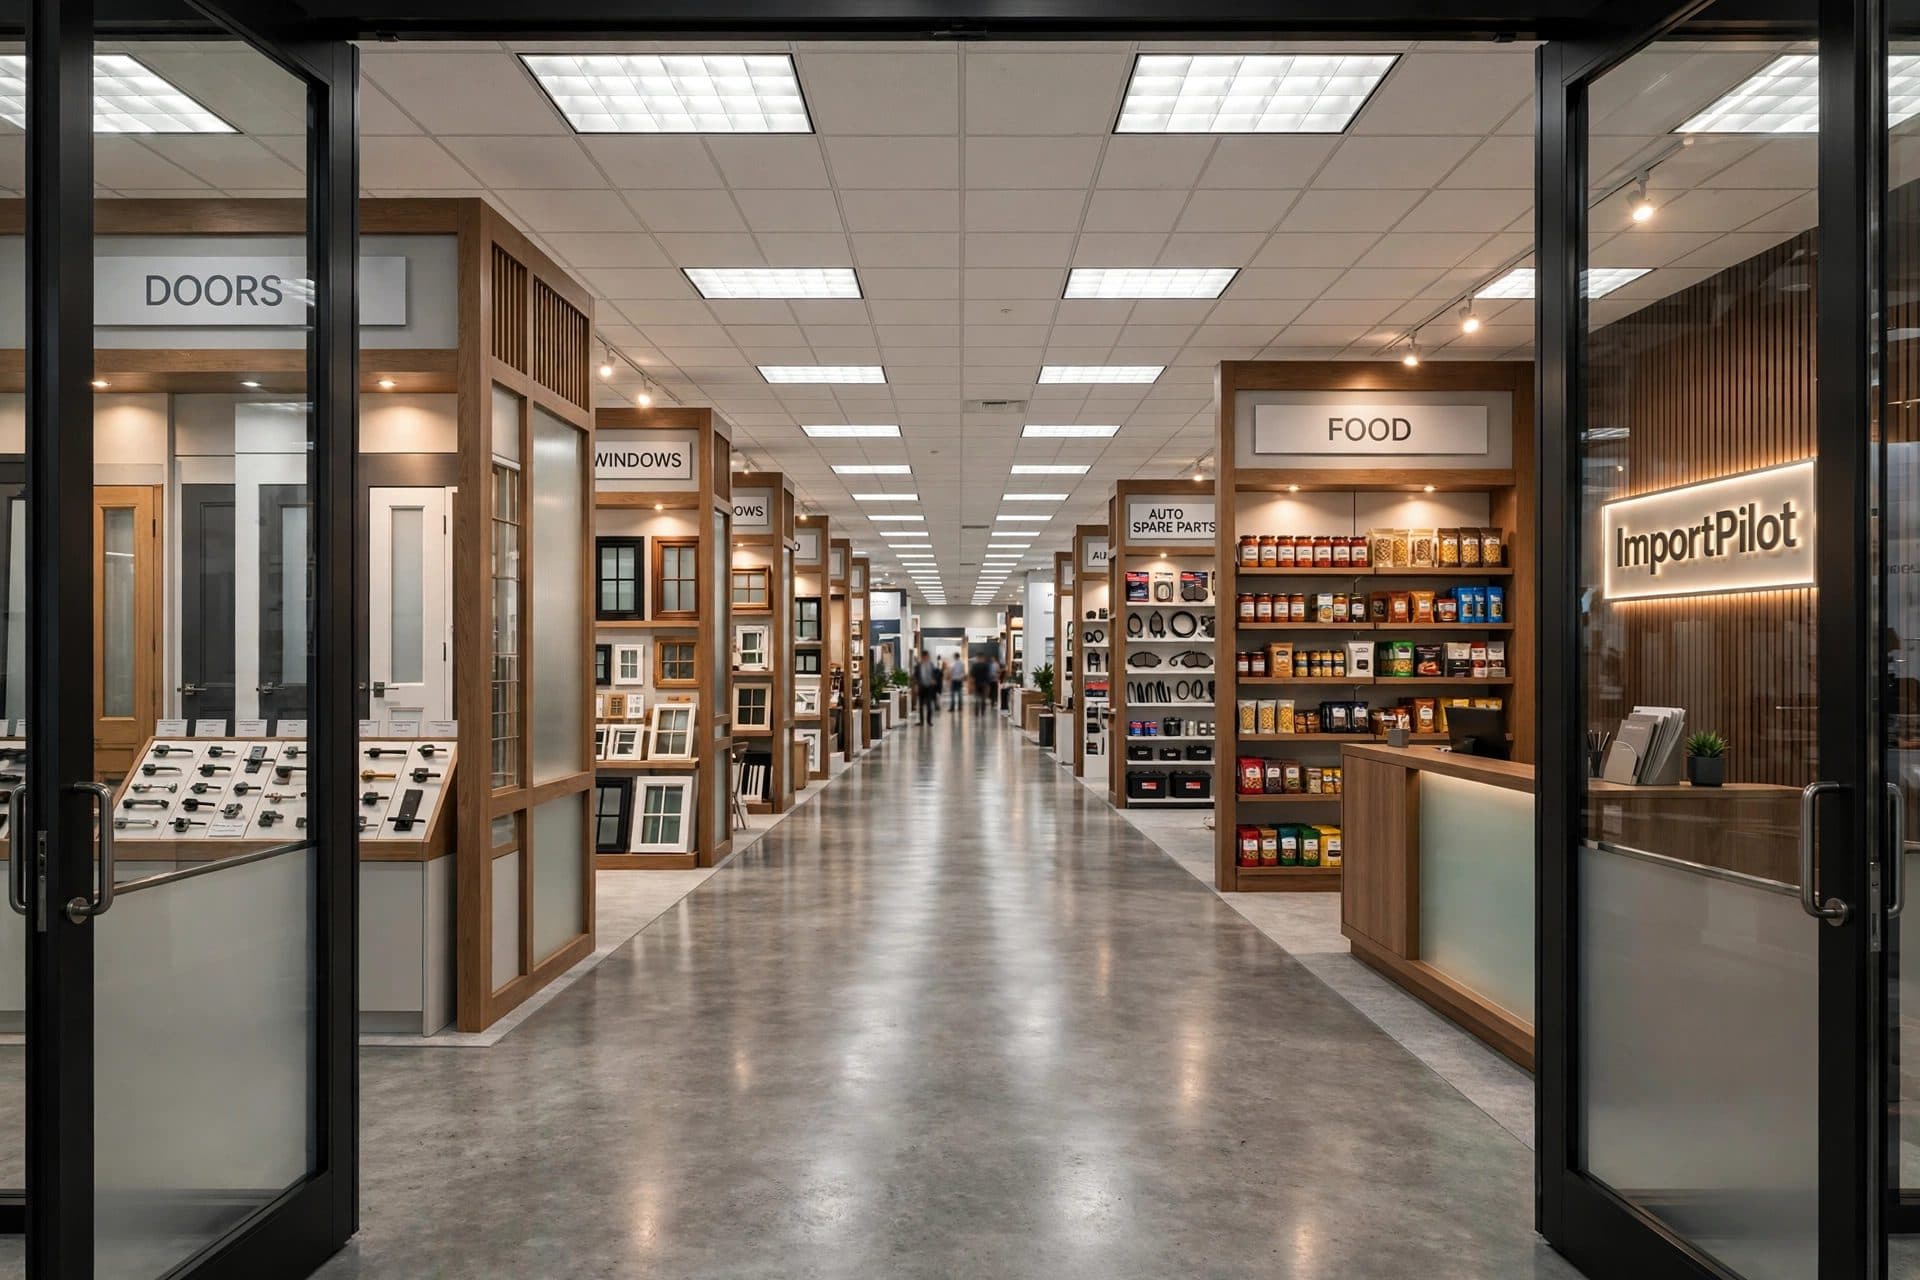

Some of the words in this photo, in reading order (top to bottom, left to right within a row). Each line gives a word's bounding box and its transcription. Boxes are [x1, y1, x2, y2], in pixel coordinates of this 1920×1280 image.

[146, 274, 283, 307] DOORS
[1328, 417, 1412, 442] FOOD
[595, 452, 682, 468] WINDOWS
[732, 505, 764, 517] OWS
[1149, 508, 1184, 520] AUTO
[1132, 521, 1173, 533] SPARE
[1177, 521, 1216, 533] PARTS
[1617, 501, 1797, 575] ImportPilot
